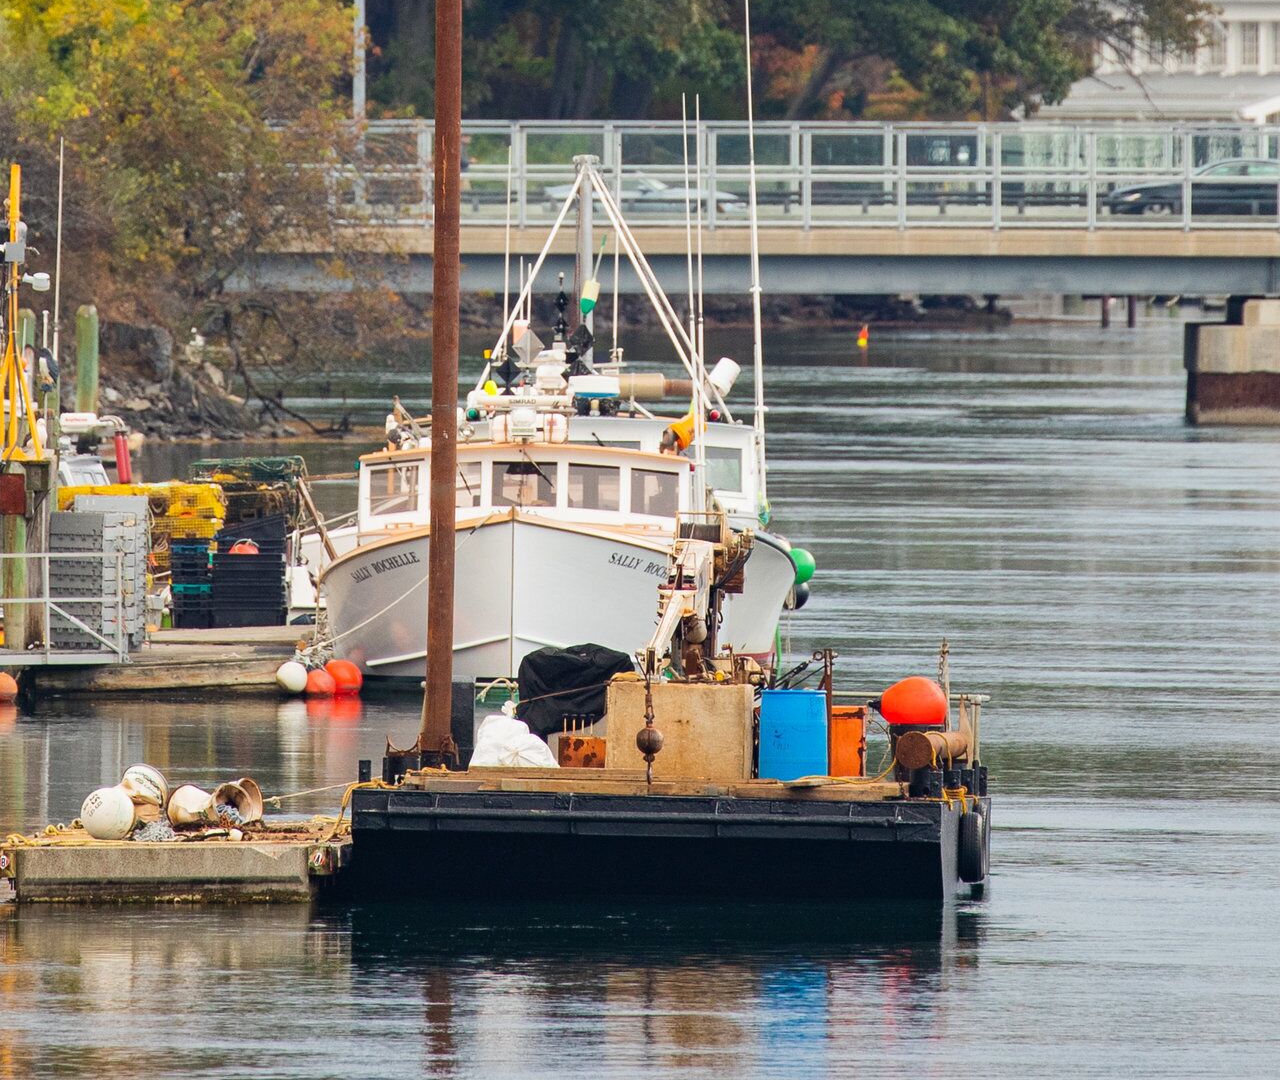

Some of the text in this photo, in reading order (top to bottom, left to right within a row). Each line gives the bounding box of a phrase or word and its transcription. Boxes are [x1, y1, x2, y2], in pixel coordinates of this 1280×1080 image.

[351, 551, 420, 583] SALLY ROCHELLE
[608, 552, 642, 569] SALLY
